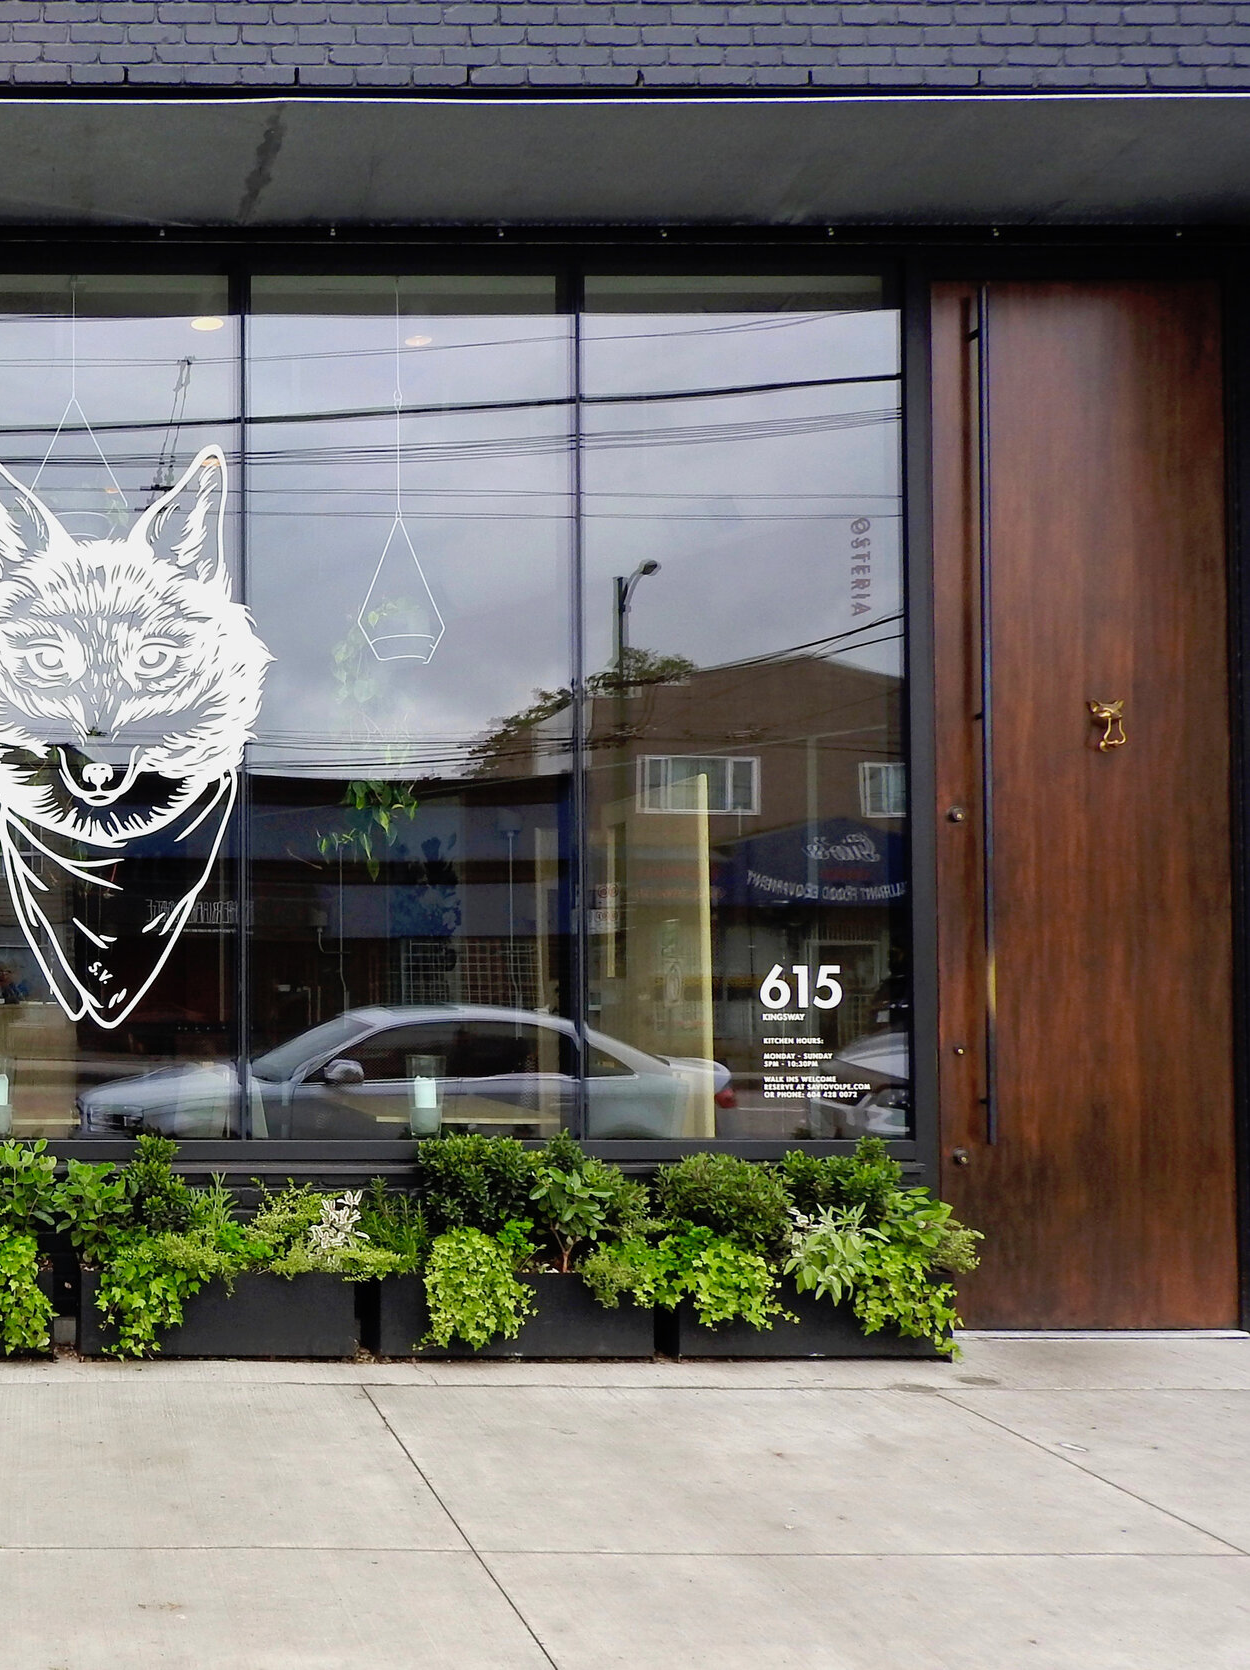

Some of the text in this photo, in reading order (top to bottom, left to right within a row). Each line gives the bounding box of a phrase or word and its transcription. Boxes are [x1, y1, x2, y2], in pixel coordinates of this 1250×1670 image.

[850, 517, 871, 617] OSTERIA
[88, 961, 113, 984] S.V.
[760, 963, 843, 1009] 615
[762, 1013, 805, 1021] KINGSWAY
